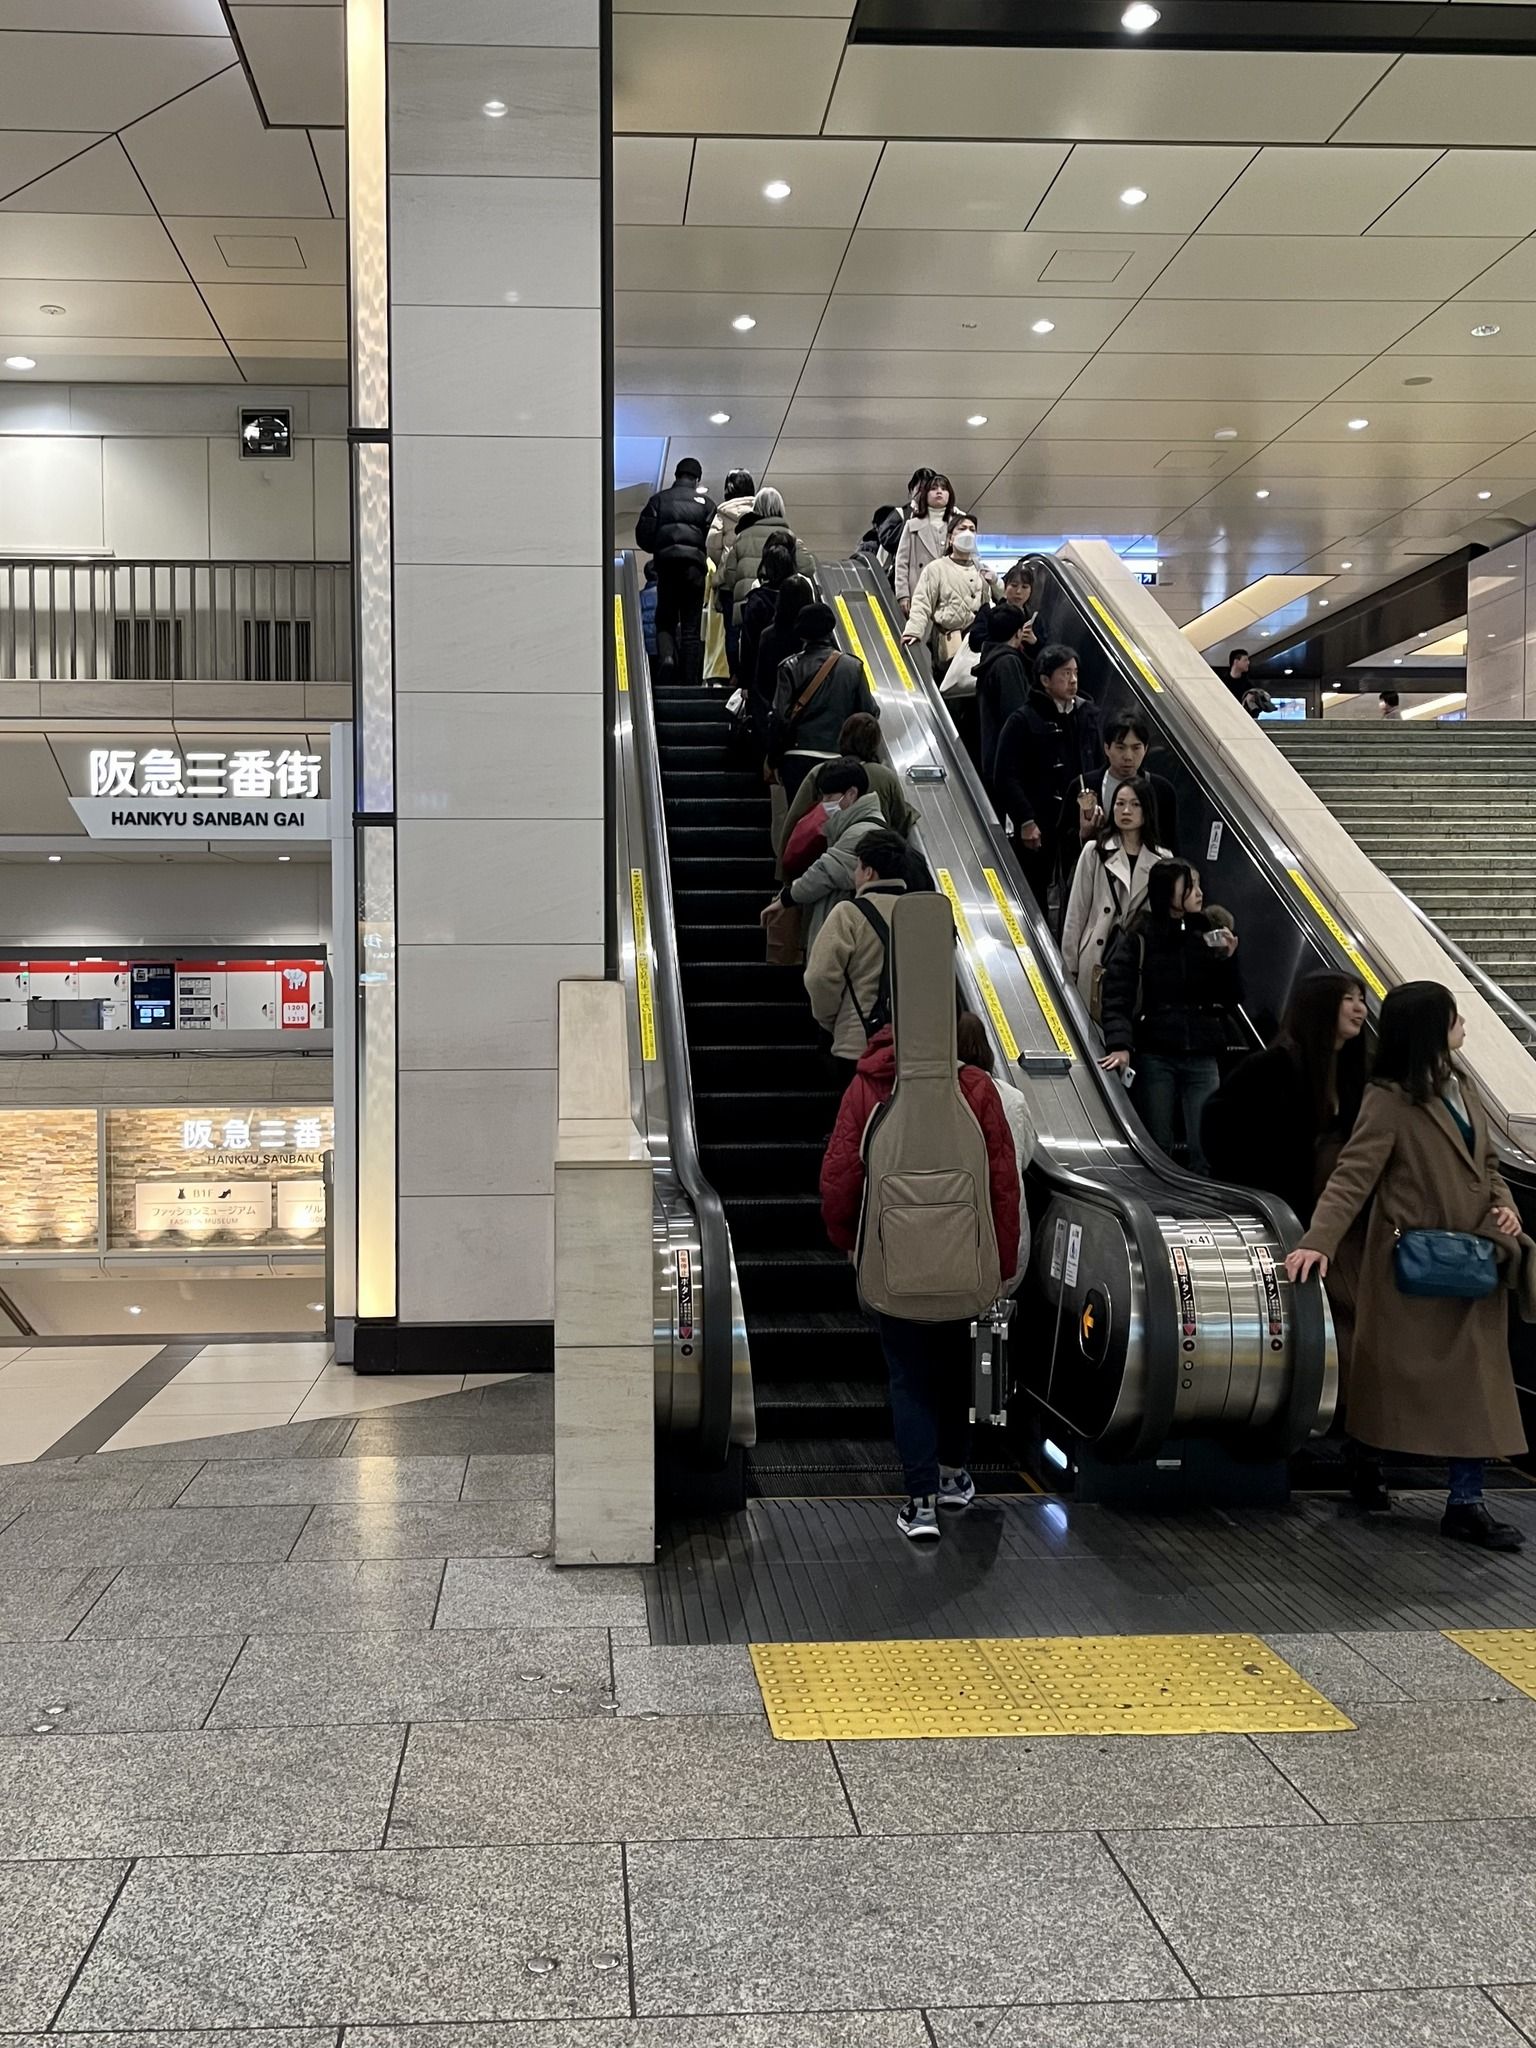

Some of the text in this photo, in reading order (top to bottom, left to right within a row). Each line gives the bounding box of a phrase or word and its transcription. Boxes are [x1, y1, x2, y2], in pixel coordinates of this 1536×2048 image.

[89, 748, 322, 798] 阪急三番街
[111, 811, 305, 827] HANKYU SANBAN GAI
[183, 1118, 335, 1149] 阪急三番
[207, 1154, 259, 1165] HANKYU
[263, 1153, 315, 1164] SANBAN
[151, 1205, 256, 1217] ファッションミュージアム
[1198, 1235, 1211, 1244] 41
